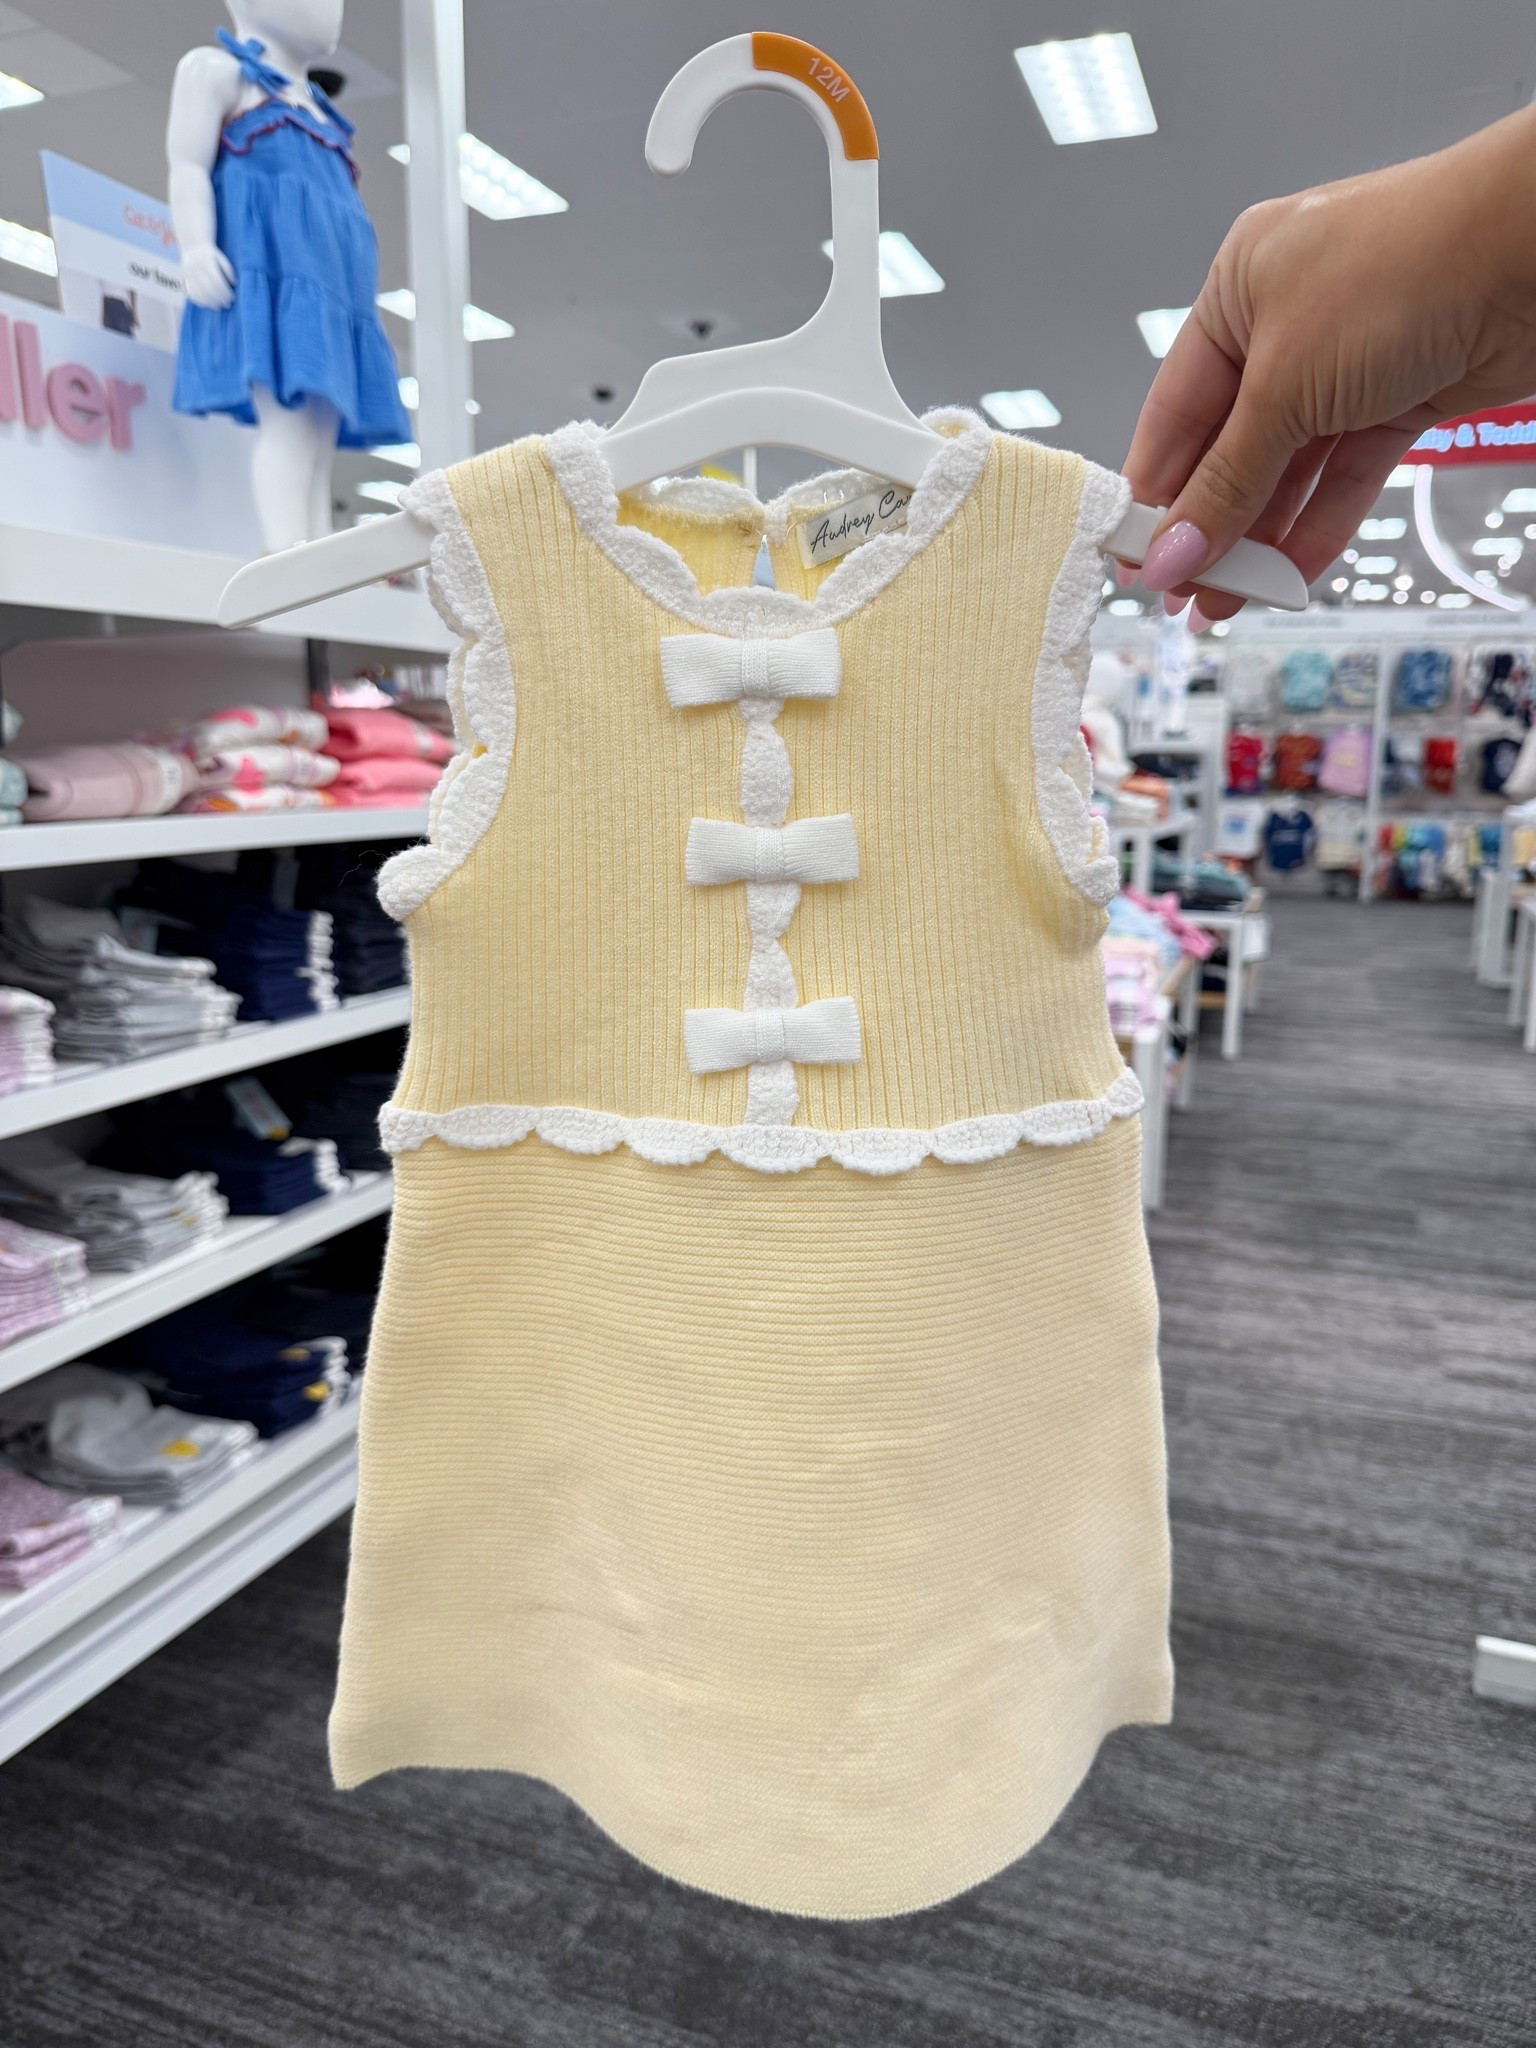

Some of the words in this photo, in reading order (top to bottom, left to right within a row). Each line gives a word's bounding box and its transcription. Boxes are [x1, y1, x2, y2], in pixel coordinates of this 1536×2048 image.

[808, 57, 850, 103] 12M
[1455, 422, 1477, 448] &
[810, 513, 875, 554] Audrey
